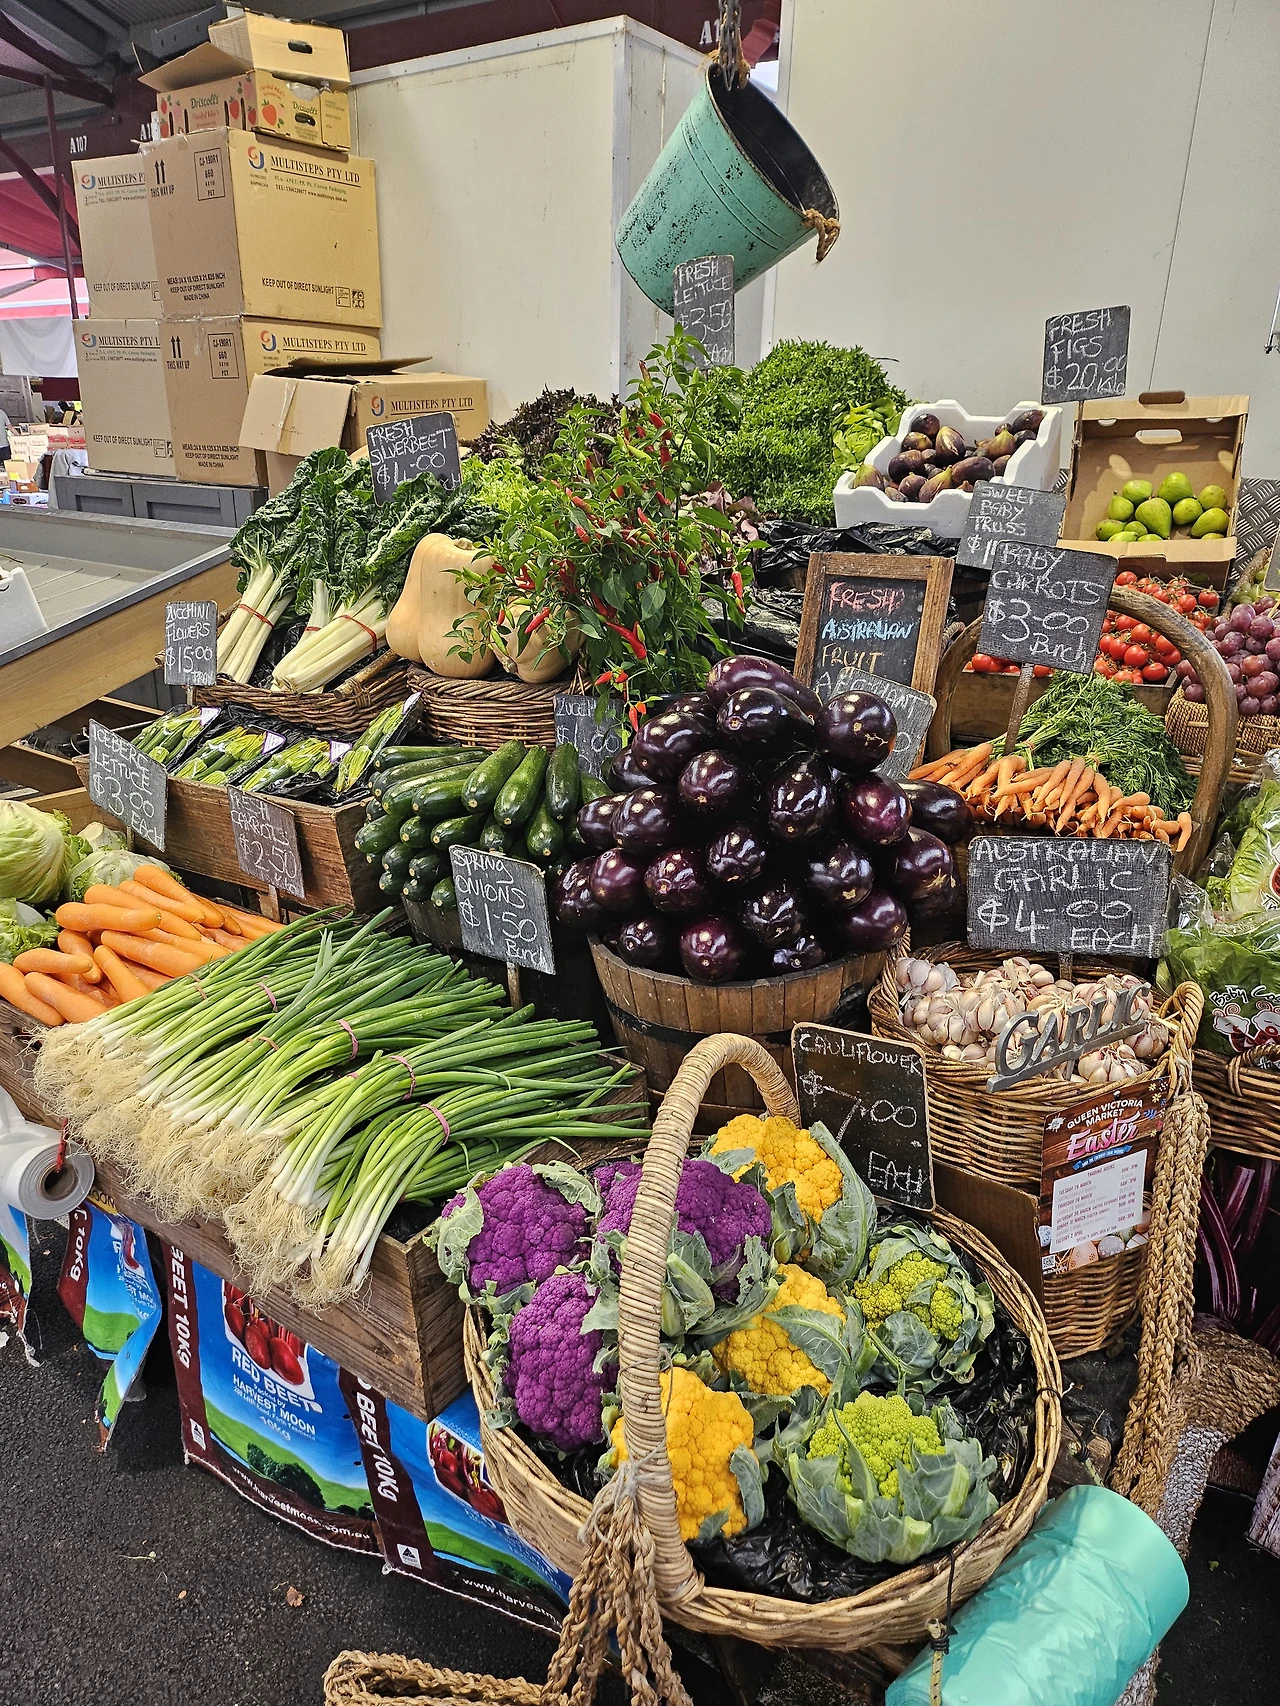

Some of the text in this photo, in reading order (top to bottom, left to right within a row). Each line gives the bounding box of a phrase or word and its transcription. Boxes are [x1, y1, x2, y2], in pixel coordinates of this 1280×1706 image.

[699, 19, 720, 45] A1
[70, 136, 88, 154] A107
[140, 123, 152, 141] A1
[98, 173, 136, 187] MULTISTEPS
[270, 156, 360, 182] MULTISTEPS PTY LTD
[150, 188, 162, 198] THIS
[162, 186, 170, 196] WAY
[170, 184, 174, 194] UP
[262, 278, 334, 294] KEEP OUT OF DIRECT SUNLIGHT
[678, 260, 719, 287] FRESH
[94, 284, 102, 292] KEEP
[102, 283, 110, 291] OUT
[116, 282, 131, 290] DIRECT
[131, 282, 150, 290] SUNLIGHT
[170, 286, 180, 294] KEEP
[180, 284, 188, 293] OUT
[193, 284, 206, 292] DIRECT
[206, 282, 225, 290] SUNLIGHT
[674, 274, 732, 306] LETTUCE
[1049, 308, 1111, 342] FRESH
[98, 336, 139, 346] MULTISTEPS
[140, 336, 152, 346] PTY
[282, 337, 366, 352] MULTISTEPS PTY LTD
[1050, 336, 1103, 364] FIGS
[167, 360, 190, 370] THIS WAY UP
[390, 398, 472, 412] MULTISTEPS PTY LTD
[93, 434, 153, 446] KEEP OUT OF DIRECT SUNLIGHT
[368, 420, 414, 446] FRESH
[370, 428, 453, 466] SILVERBEET
[981, 486, 1040, 506] SWEET
[981, 500, 1024, 522] BABY
[968, 516, 1026, 536] TRUSS
[1000, 542, 1066, 579] BABY
[992, 571, 1106, 606] CARROTS
[166, 602, 210, 624] ZUCCHINI
[822, 618, 914, 642] AUSTRALIAN
[822, 642, 884, 674] FRUIT
[94, 724, 149, 770] ICEBERG
[94, 745, 152, 796] LETTUCE
[132, 810, 164, 852] EACH
[976, 839, 1158, 864] AUSTRALIAN
[452, 850, 514, 884] SPRING
[994, 864, 1143, 892] GARLIC
[456, 874, 527, 909] ONIONS
[1070, 923, 1154, 958] EACH
[1209, 984, 1248, 1007] Baby
[995, 982, 1151, 1078] GARLIC
[800, 1032, 923, 1076] CAULIFLOWER
[1067, 1100, 1143, 1130] QUEEN VICTORIA
[1086, 1108, 1124, 1128] MARKET
[1066, 1111, 1141, 1160] Easter
[868, 1150, 928, 1195] EACH
[70, 1227, 86, 1282] 10Kg
[232, 1346, 310, 1412] RED BEET
[233, 1374, 316, 1435] HARVEST MOON
[278, 1400, 286, 1408] by
